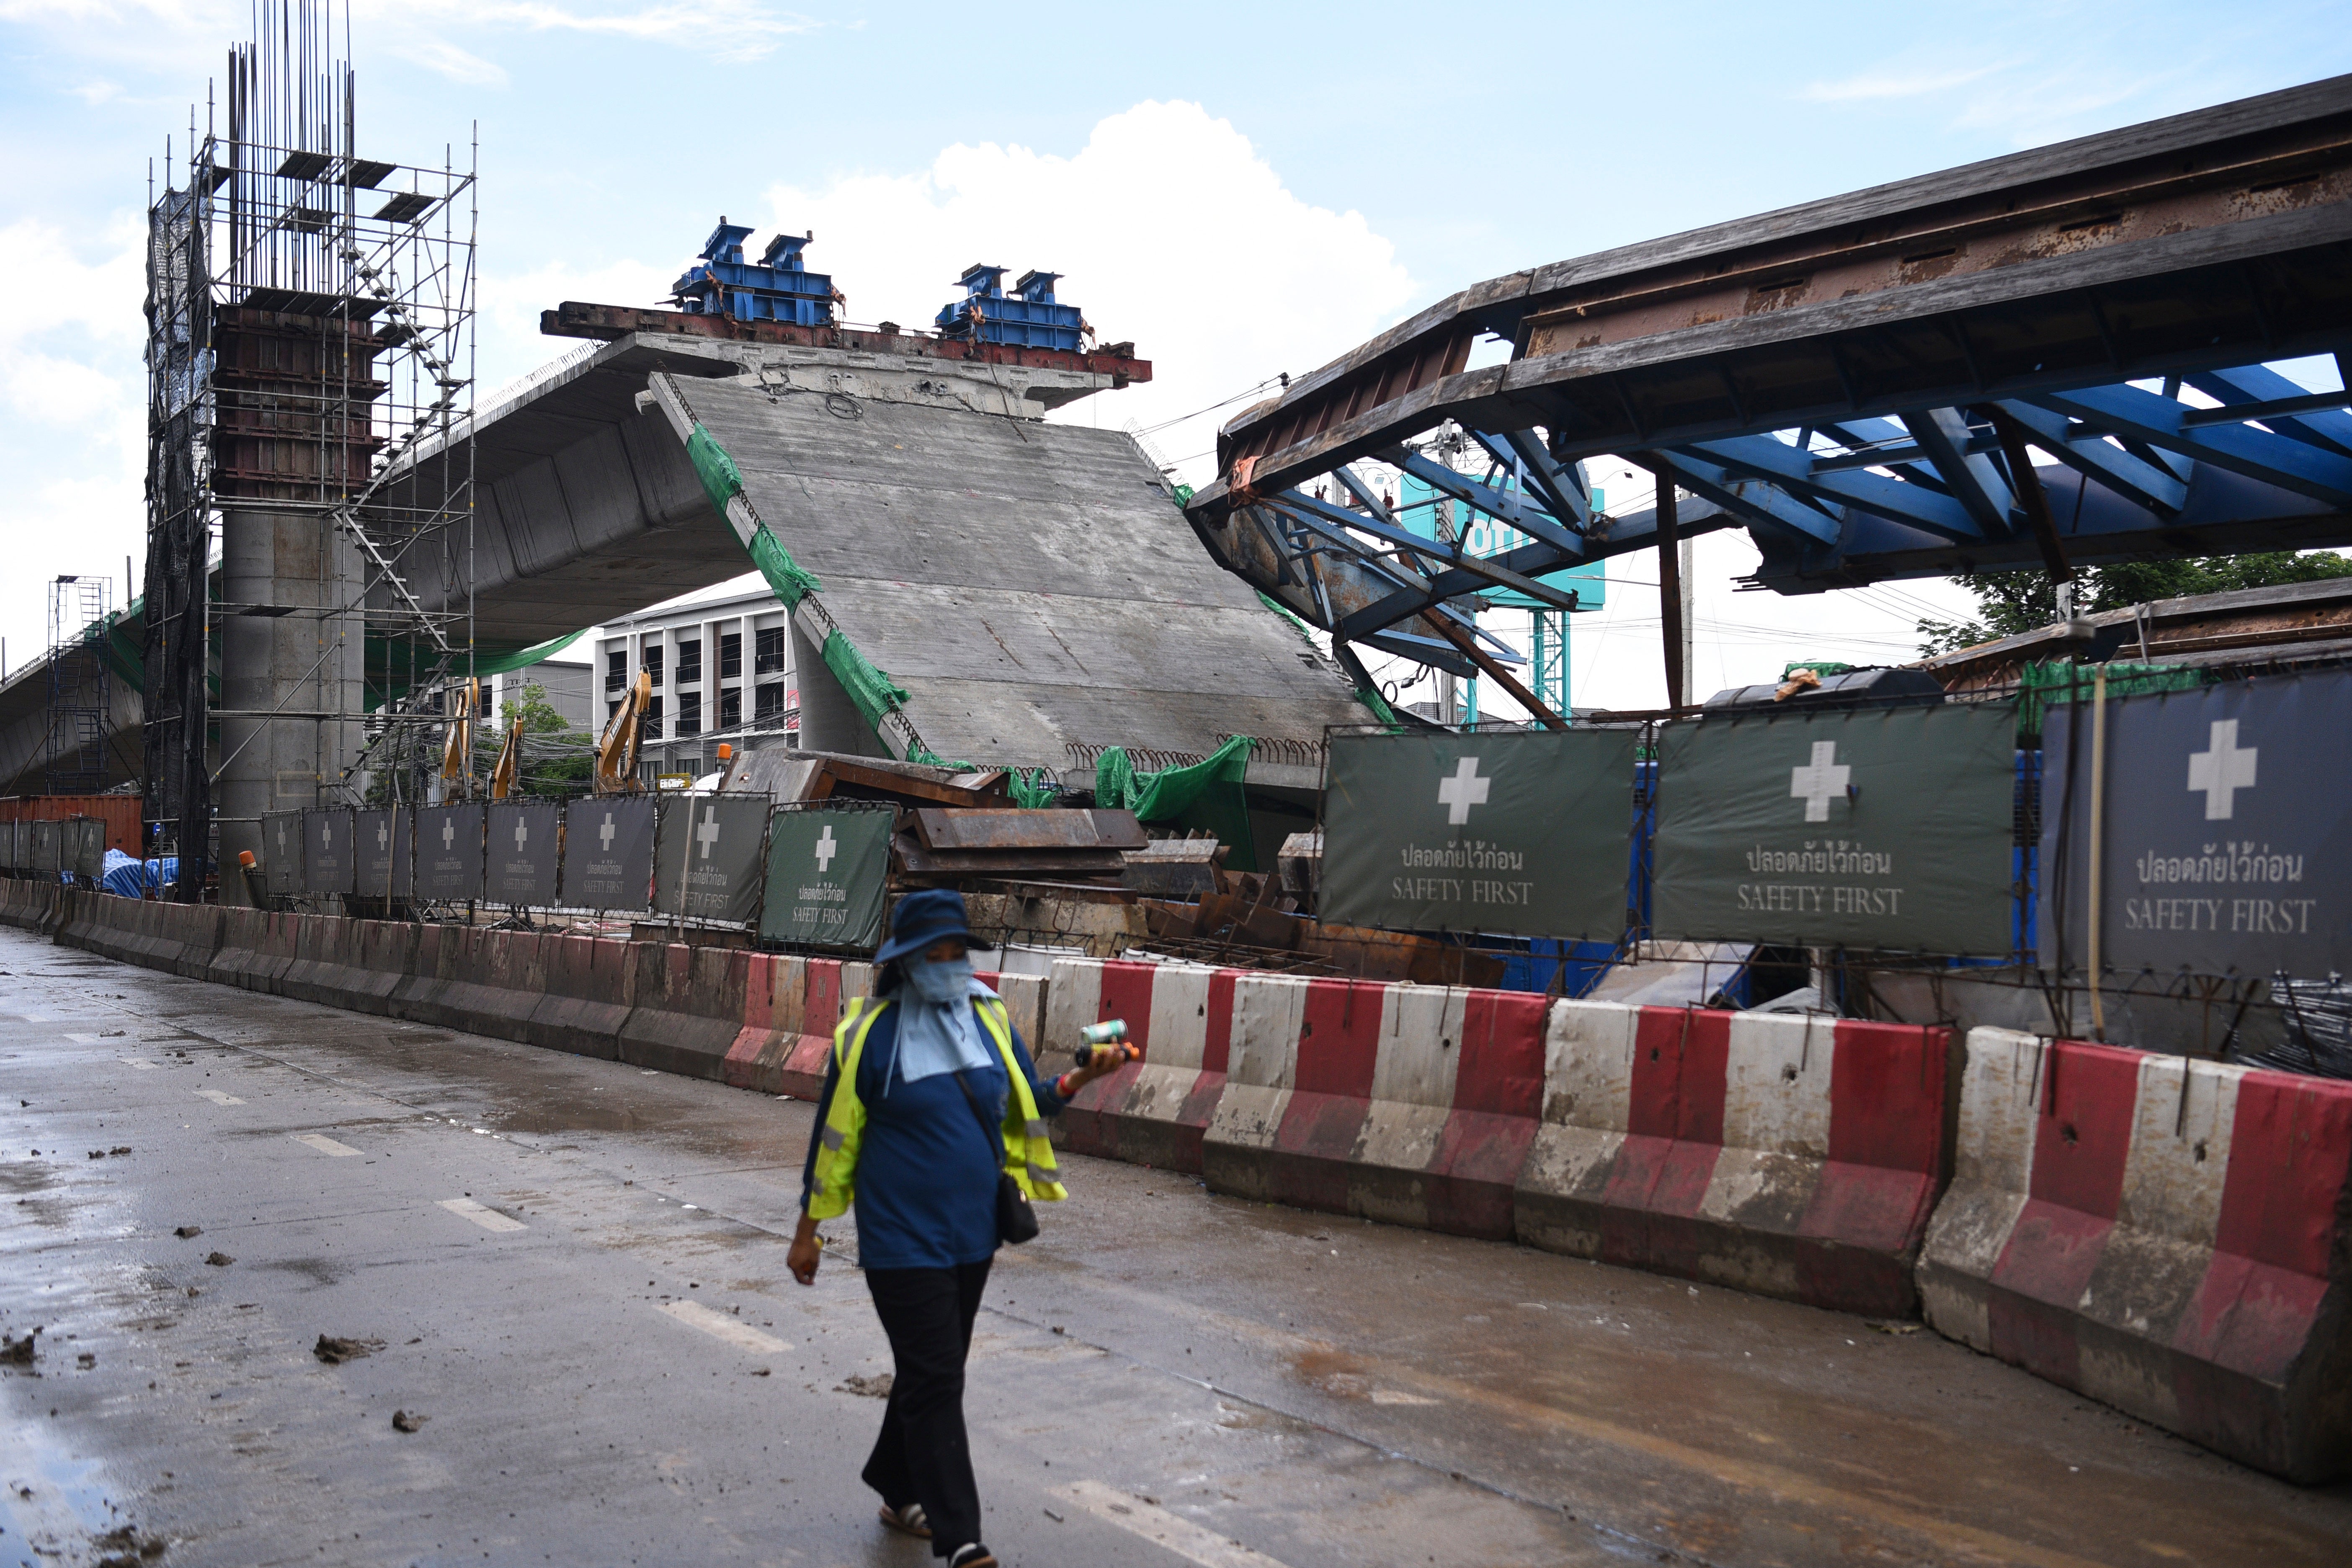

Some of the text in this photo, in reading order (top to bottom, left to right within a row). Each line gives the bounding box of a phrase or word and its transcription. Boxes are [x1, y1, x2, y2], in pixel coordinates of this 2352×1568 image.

[1401, 841, 1524, 871] ปลอดภัยไว้ก่อน
[1746, 840, 1892, 874] ปลอดภัยไว้ก่อน
[2136, 841, 2304, 884] ปลอดภัยไว้ก่อน
[583, 880, 624, 893] SAFETY FIRST
[704, 893, 730, 909] FIRST
[799, 882, 846, 902] ปลอดภัยไว้ก่อน
[1392, 877, 1533, 905] SAFETY FIRST
[1737, 884, 1903, 916] SAFETY FIRST
[793, 907, 848, 924] SAFETY FIRST
[2125, 897, 2316, 933] SAFETY FIRST
